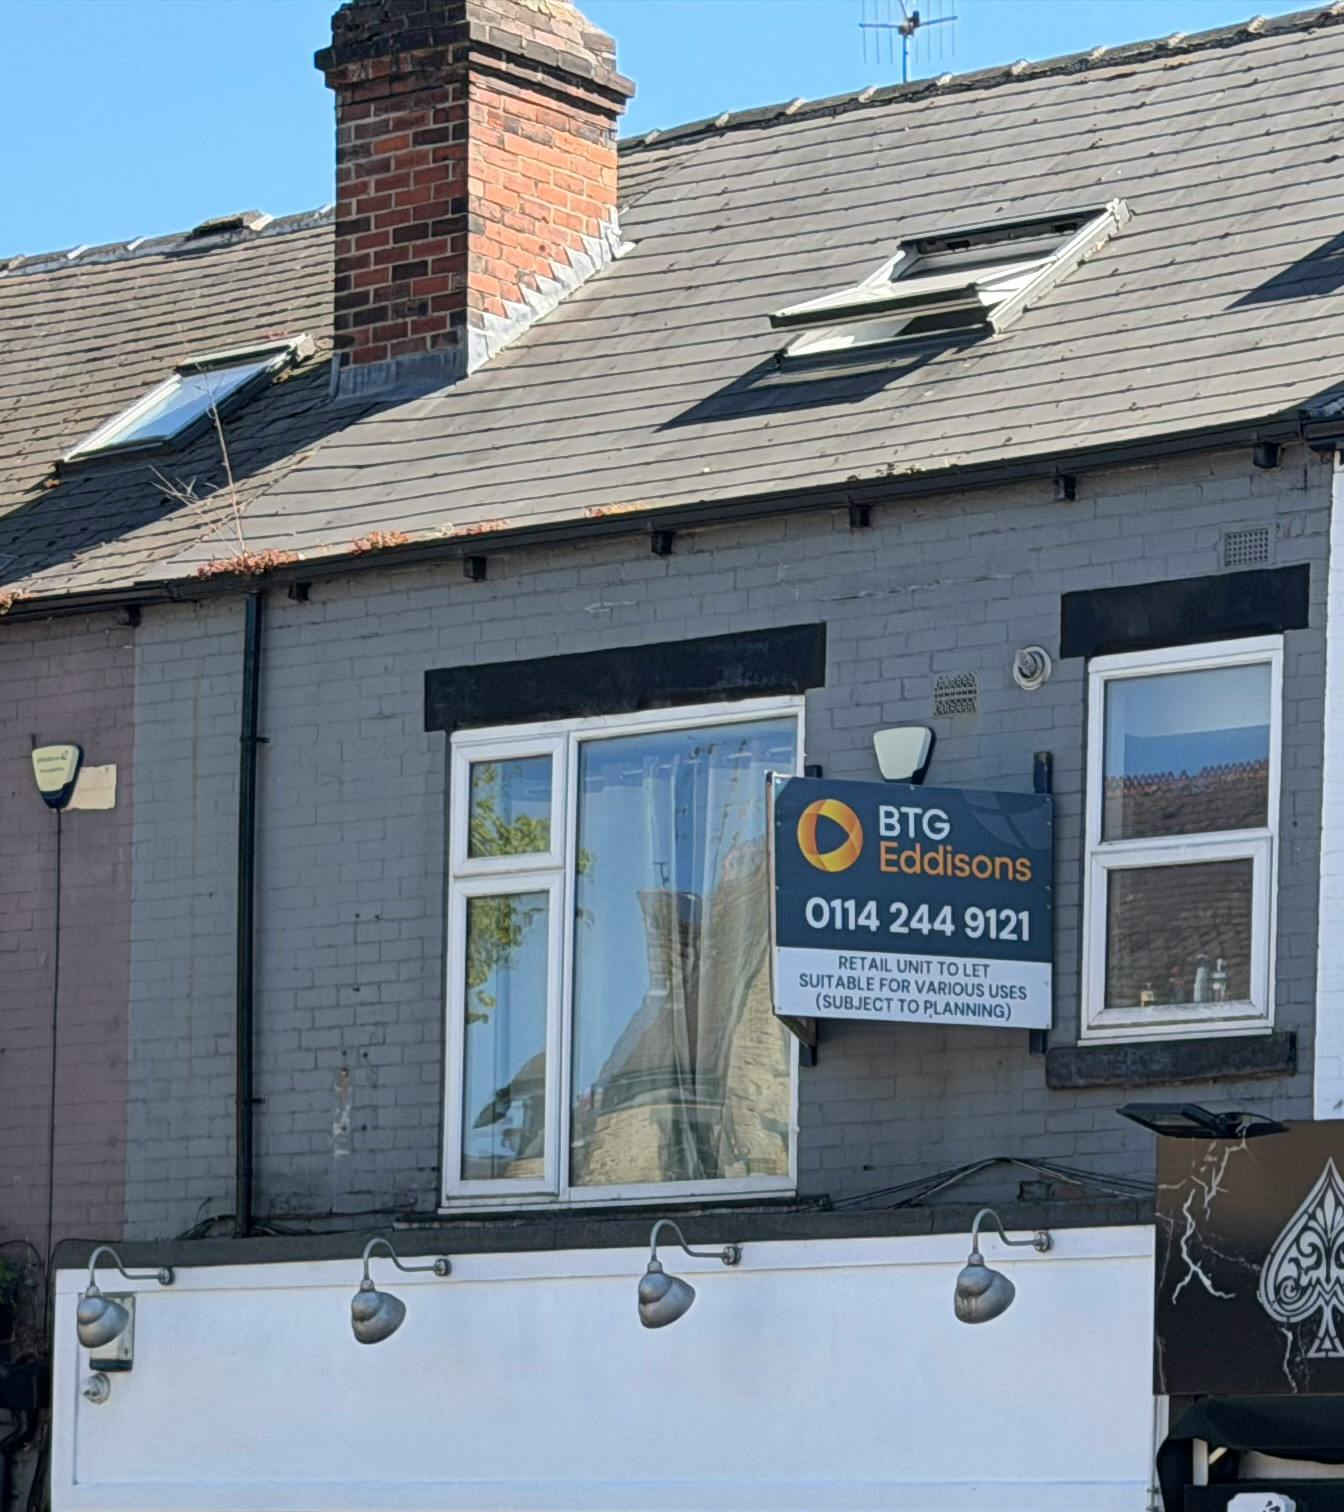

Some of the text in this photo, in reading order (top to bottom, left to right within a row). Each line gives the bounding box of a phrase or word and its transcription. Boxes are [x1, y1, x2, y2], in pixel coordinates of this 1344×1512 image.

[879, 805, 950, 841] BTG
[880, 841, 1032, 882] Eddisons
[806, 896, 1030, 942] 0114 244 9121
[838, 955, 990, 979] RETAIL UNIT TO LET
[799, 973, 1027, 1001] SUITABLE FOR VARIOUS USES
[815, 992, 1012, 1021] (SUBJECT TO PLANNING)
